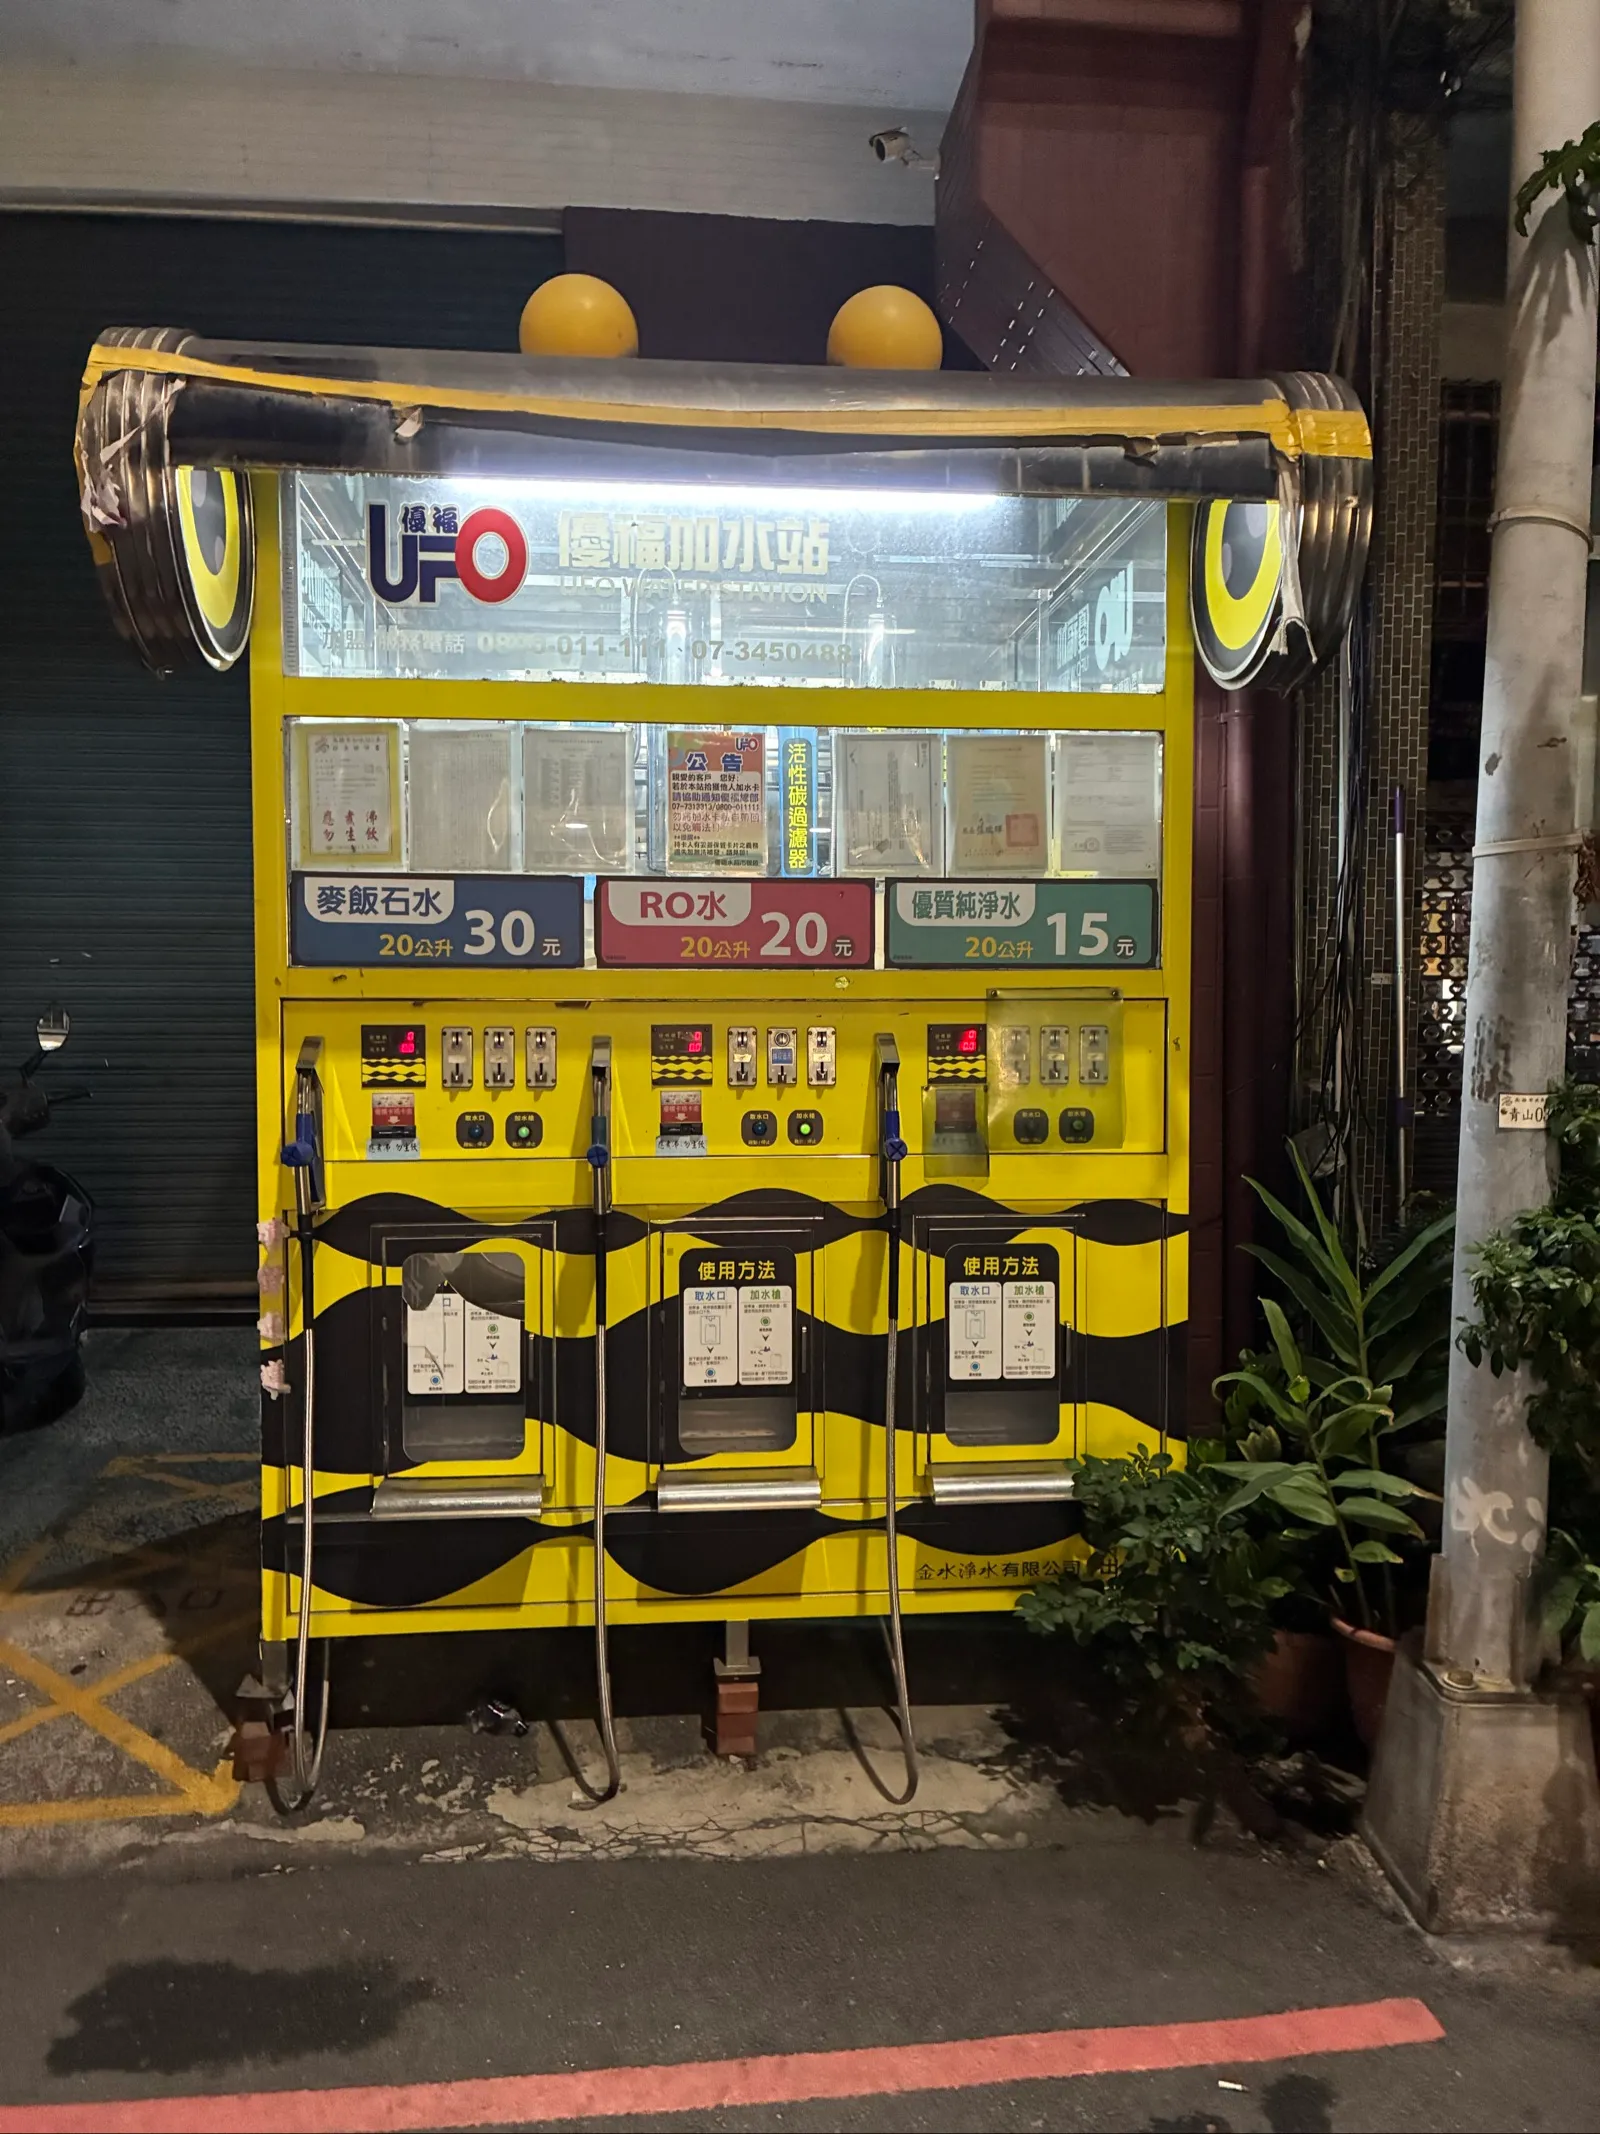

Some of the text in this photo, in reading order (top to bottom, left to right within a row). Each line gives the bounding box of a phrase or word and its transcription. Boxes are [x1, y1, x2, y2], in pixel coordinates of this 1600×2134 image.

[402, 505, 459, 534] 優福
[368, 503, 527, 603] UFO
[558, 510, 830, 575] 優福加水站
[559, 575, 615, 598] UFO
[718, 581, 829, 605] STATION
[690, 640, 852, 664] 07-3450488
[685, 752, 744, 773] 公告
[788, 743, 808, 869] 活性碳過濾器
[316, 885, 443, 917] 麥飯石水
[639, 891, 728, 921] RO水
[911, 890, 1021, 920] 優質純淨水
[379, 909, 561, 958] 20公升 30 元
[680, 911, 852, 959] 20公升 20 元
[965, 912, 1135, 959] 20公升 15 元
[697, 1260, 776, 1281] 使用方法
[962, 1256, 1040, 1276] 使用方法
[694, 1288, 782, 1302] 取水口 加水槍
[959, 1285, 1045, 1296] 取水口 加水槍
